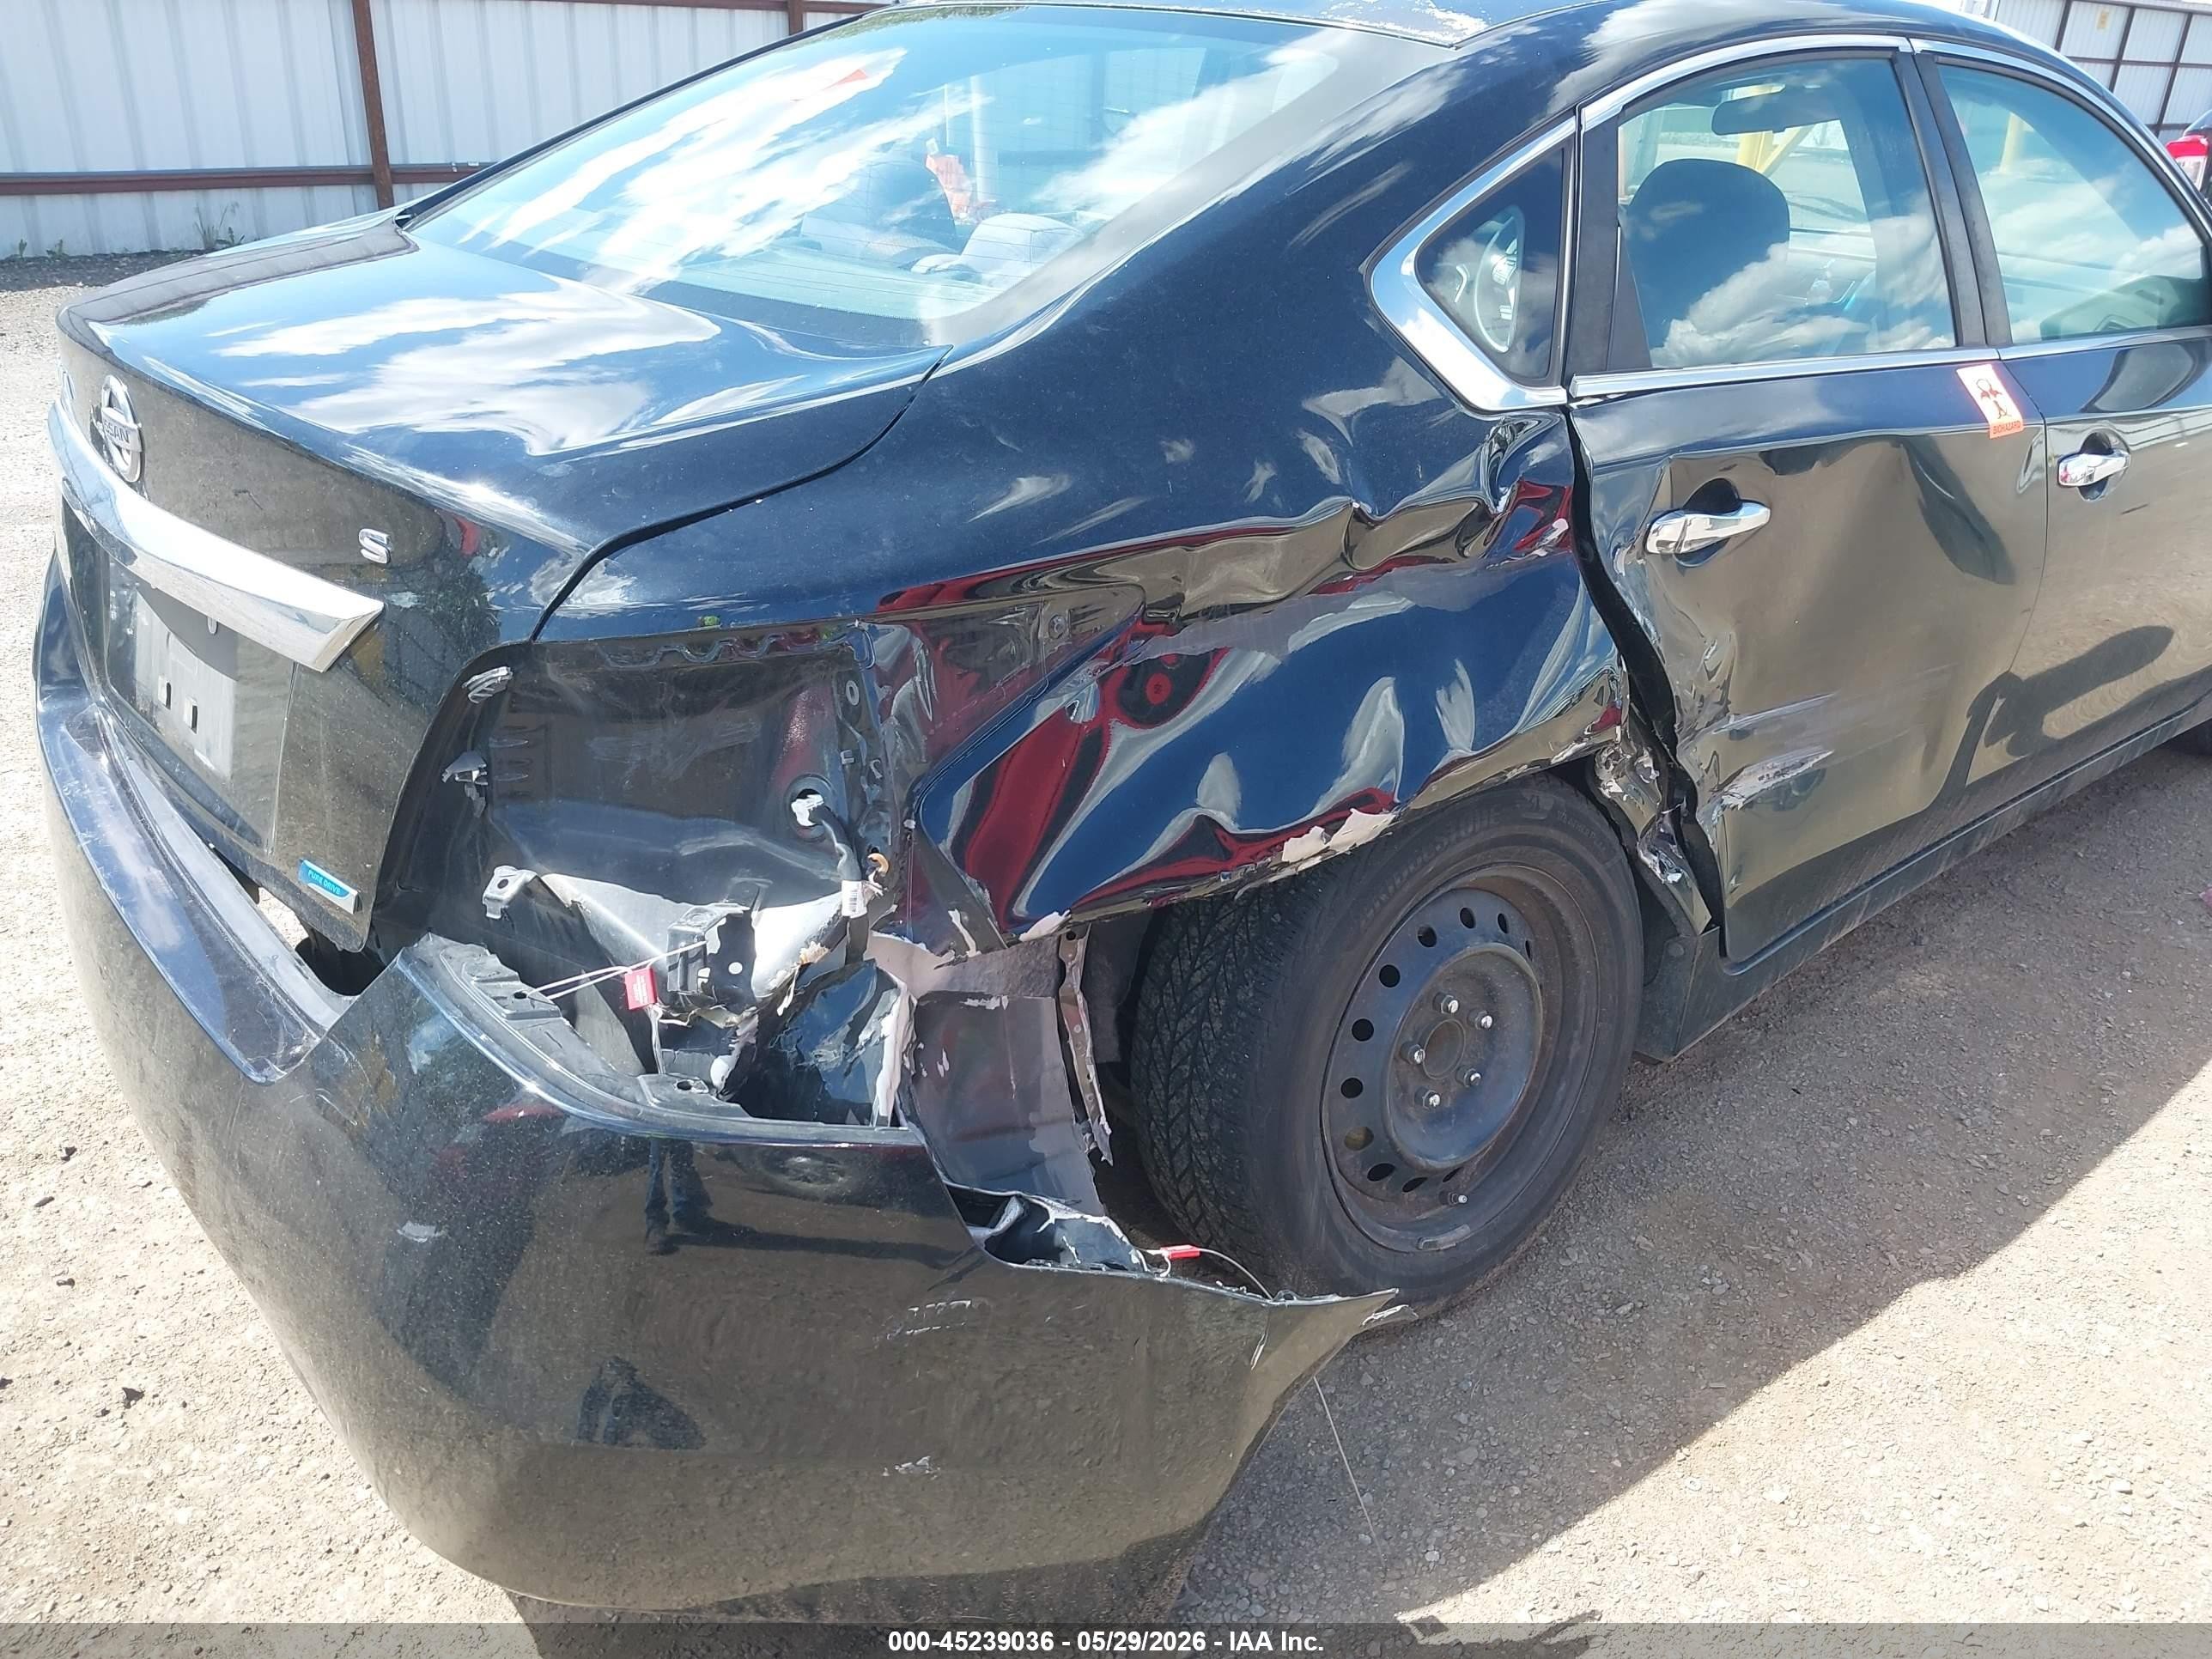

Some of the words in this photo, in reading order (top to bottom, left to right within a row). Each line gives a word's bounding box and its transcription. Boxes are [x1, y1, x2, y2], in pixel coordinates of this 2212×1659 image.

[1992, 420, 2021, 435] BIOHAZARD
[358, 527, 392, 564] S
[307, 869, 323, 885] PURE
[323, 878, 341, 895] DRIVE
